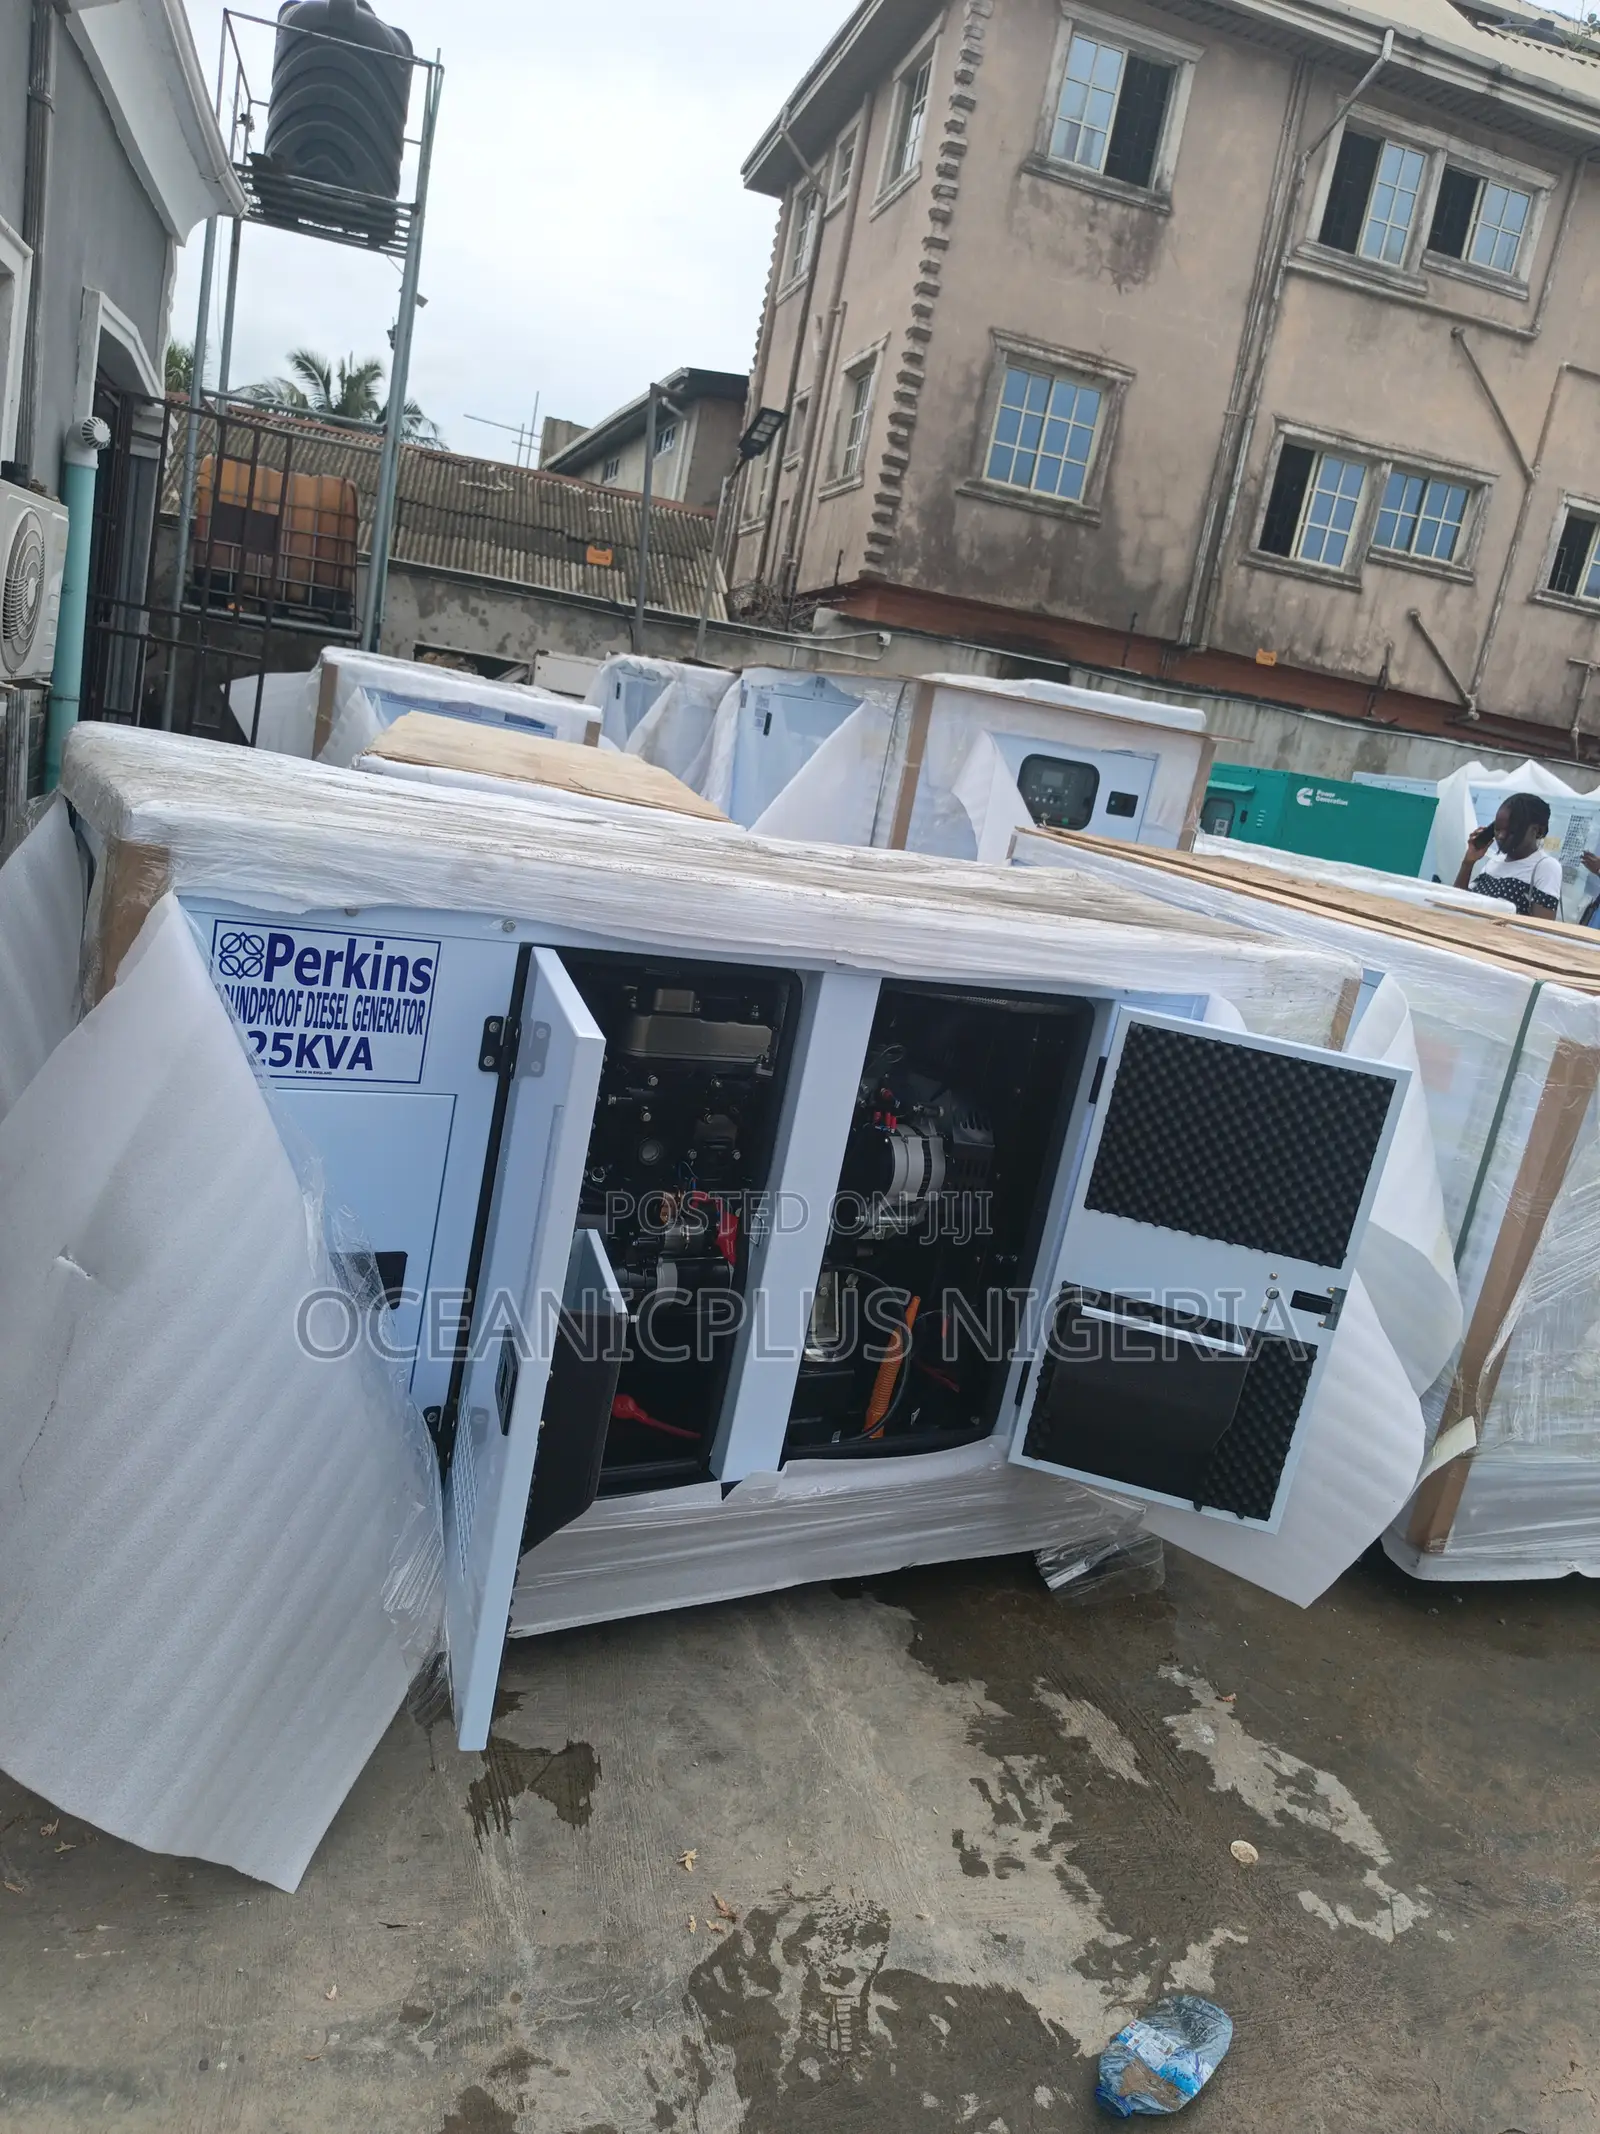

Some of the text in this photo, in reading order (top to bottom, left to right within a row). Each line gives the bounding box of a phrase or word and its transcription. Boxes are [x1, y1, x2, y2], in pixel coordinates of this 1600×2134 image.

[263, 932, 434, 994] Perkins
[223, 983, 426, 1036] UNDPROOF DIESEL GENERATOR
[247, 1030, 374, 1071] 25KVA
